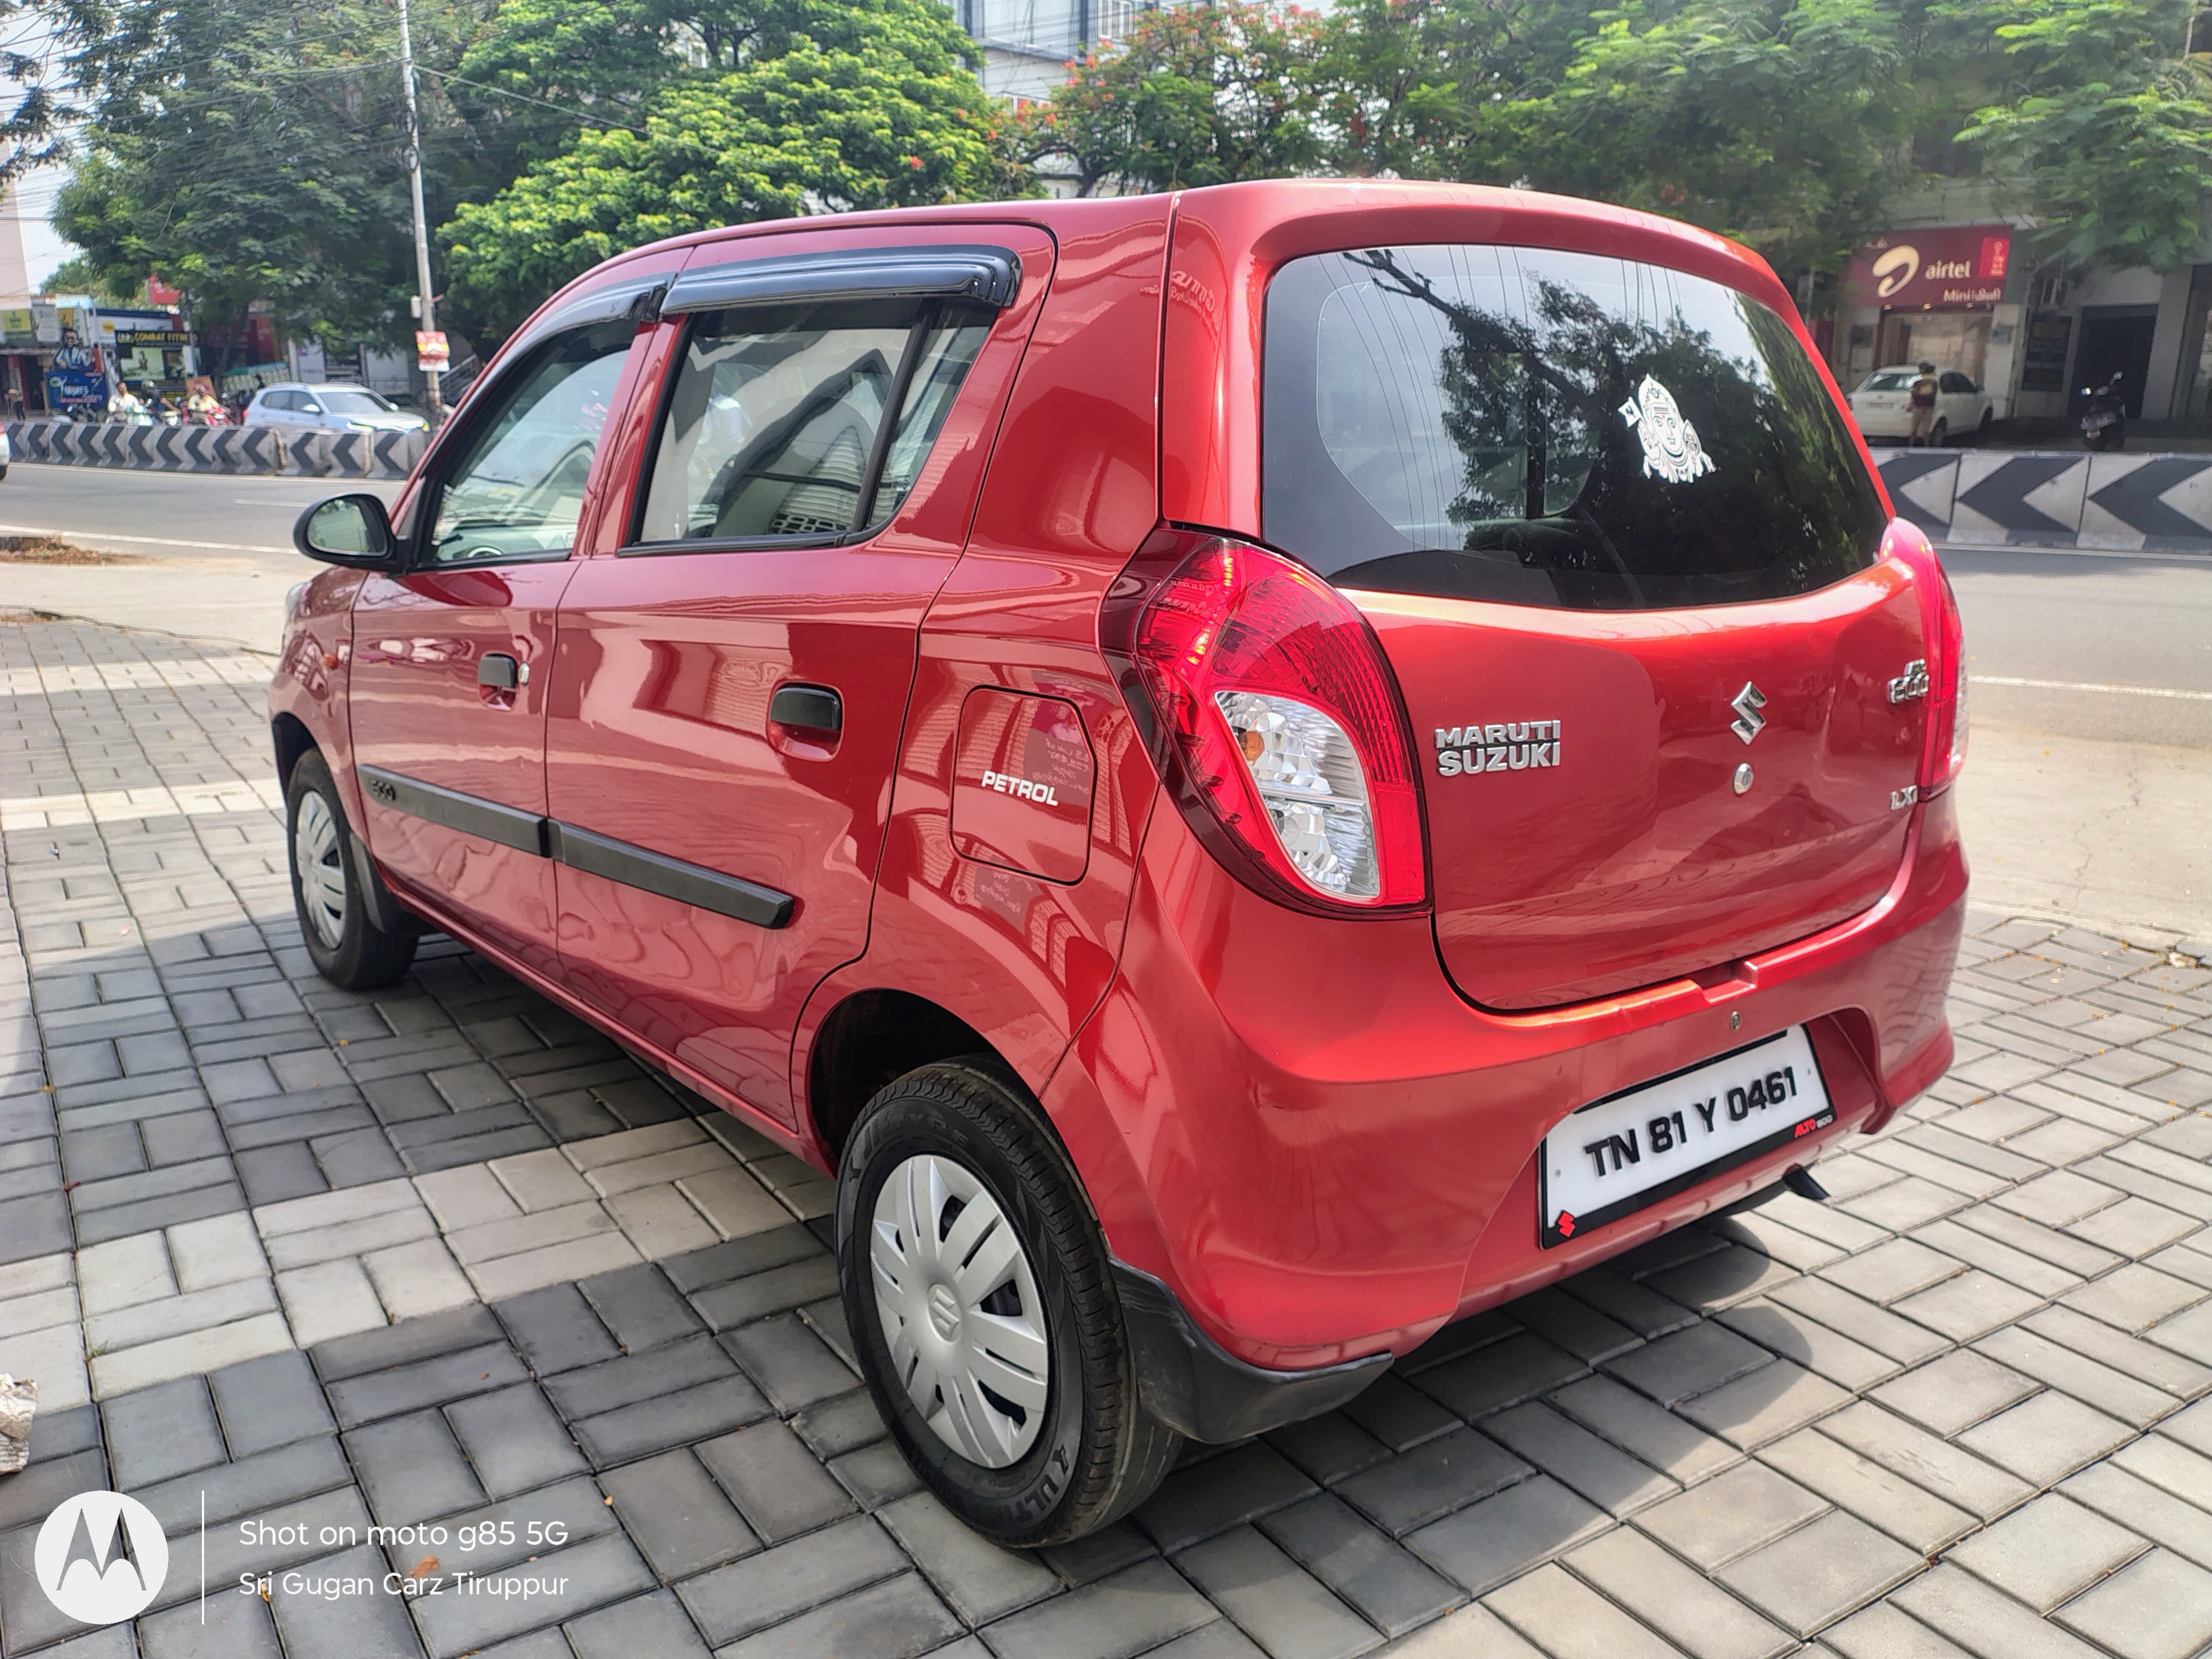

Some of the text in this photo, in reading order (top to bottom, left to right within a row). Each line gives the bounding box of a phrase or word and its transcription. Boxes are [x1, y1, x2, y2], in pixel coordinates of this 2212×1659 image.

[1925, 260, 1971, 280] airtel
[1434, 719, 1561, 749] MARUTI
[1438, 741, 1561, 777] SUZUKI
[981, 770, 1058, 806] PETROL
[1583, 1066, 1797, 1177] TN 81 Y 0461
[1794, 1117, 1817, 1138] ALTO
